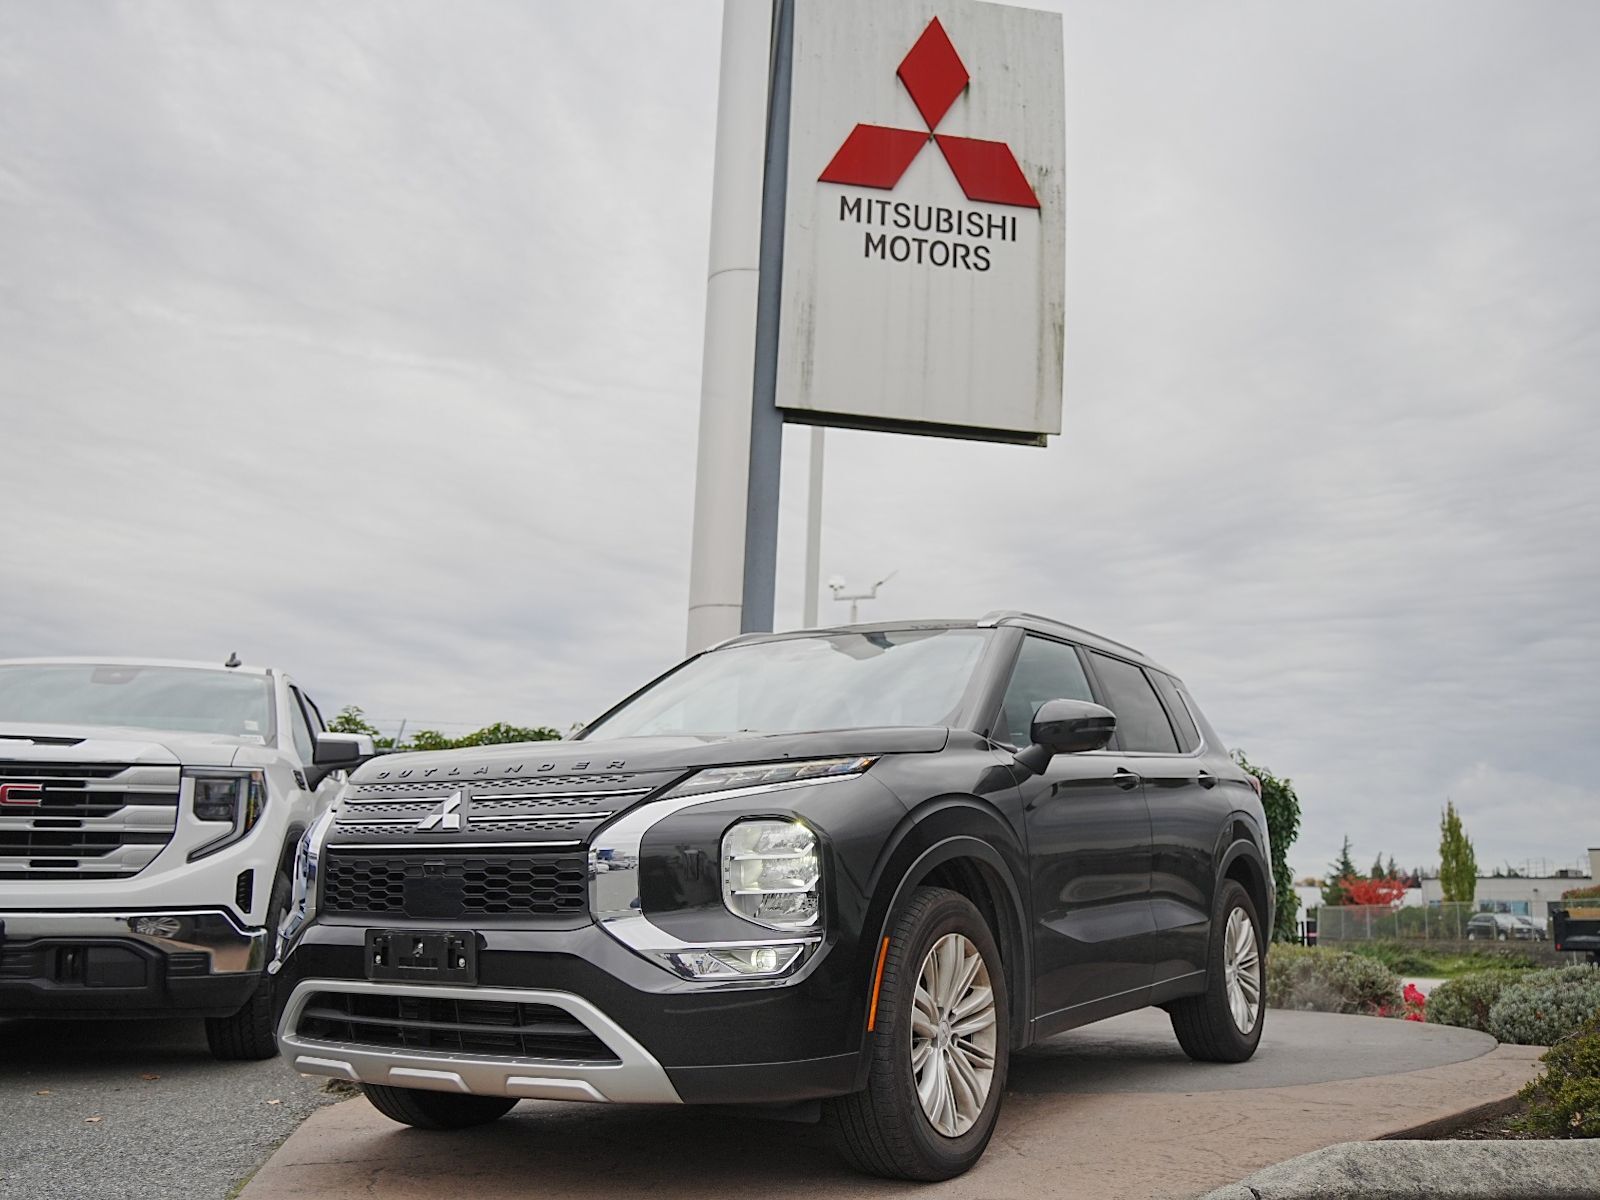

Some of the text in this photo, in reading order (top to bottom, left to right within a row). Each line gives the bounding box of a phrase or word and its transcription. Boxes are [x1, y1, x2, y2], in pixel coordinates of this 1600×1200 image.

[839, 195, 1017, 242] MITSUBISHI
[864, 232, 991, 271] MOTORS
[376, 759, 626, 780] OUTLANDER
